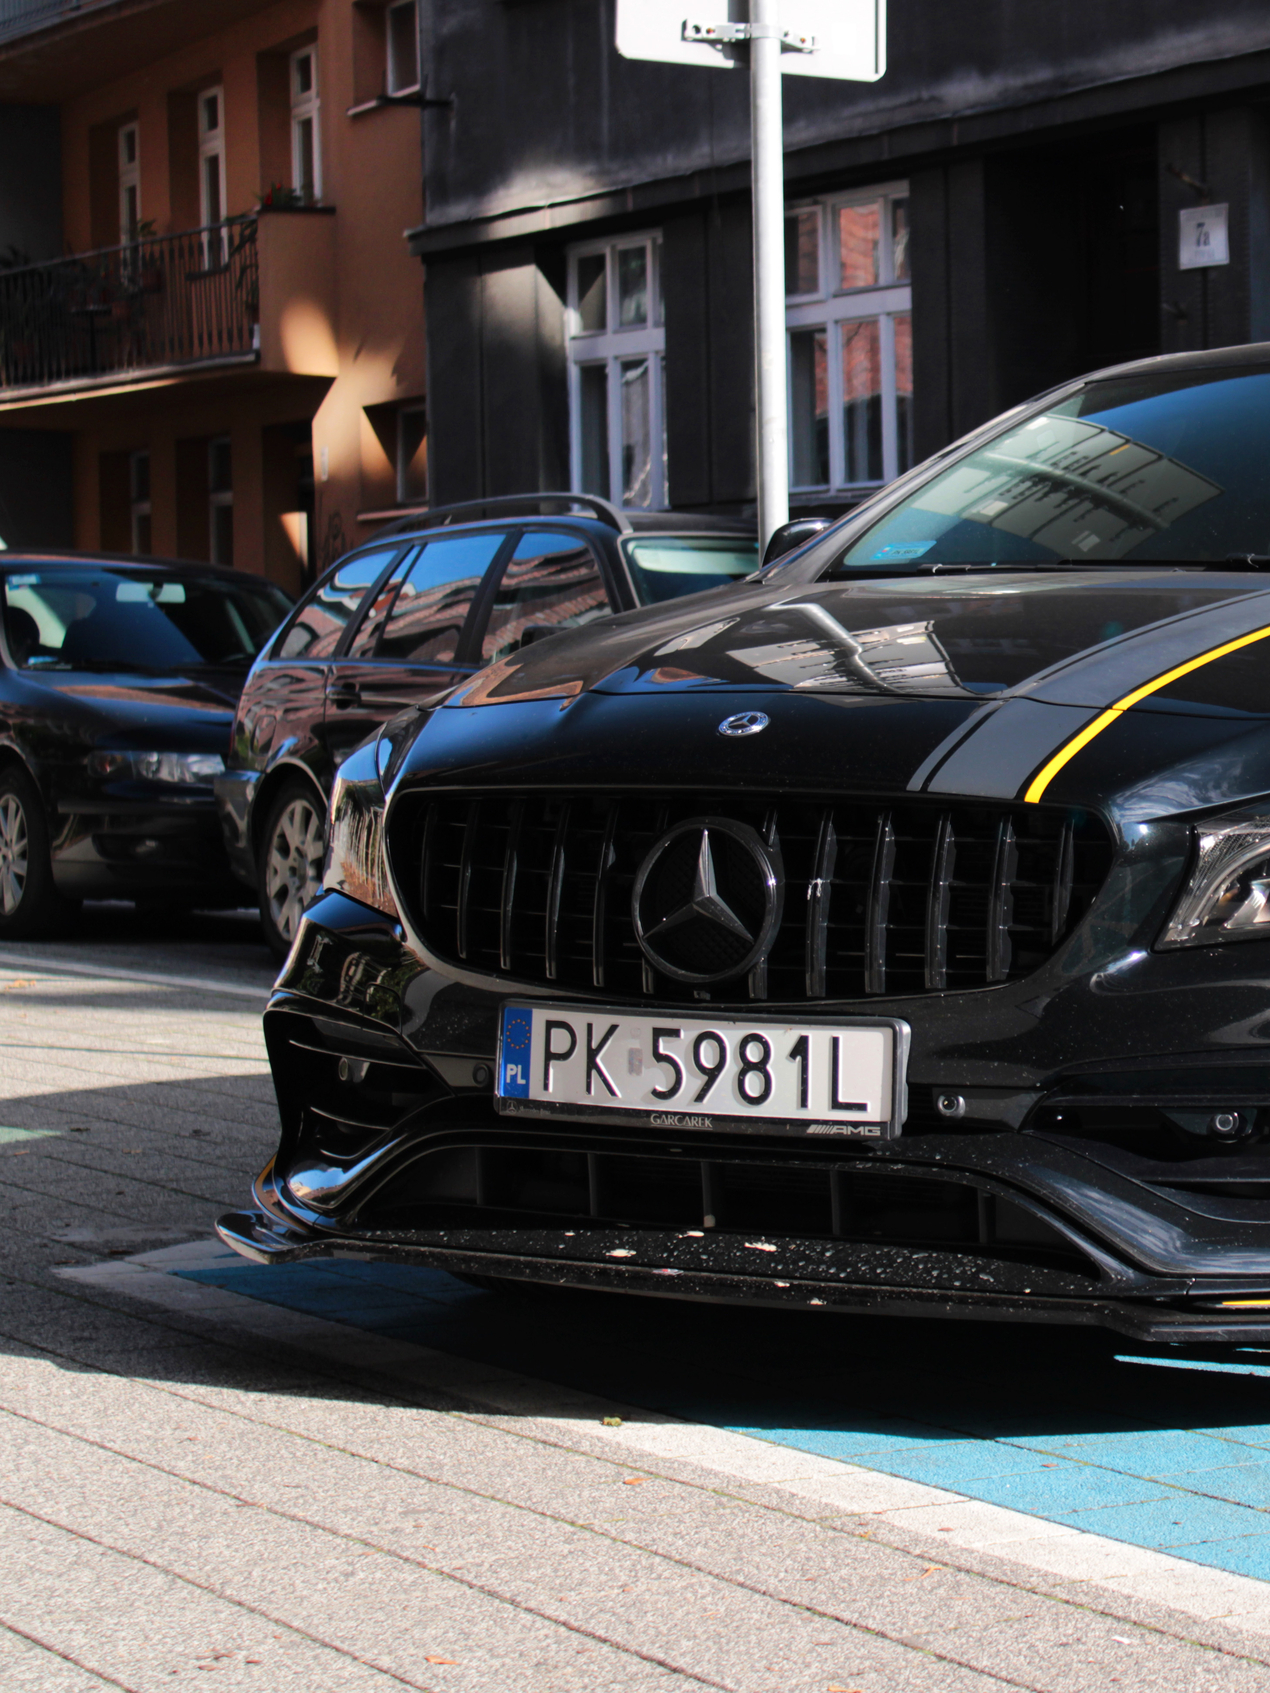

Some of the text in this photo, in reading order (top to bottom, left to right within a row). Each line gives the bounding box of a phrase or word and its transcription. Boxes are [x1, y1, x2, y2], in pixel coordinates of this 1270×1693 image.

[506, 1063, 527, 1086] PL
[542, 1019, 870, 1114] PK 5981L
[649, 1113, 714, 1129] GARCAREK
[829, 1125, 882, 1137] AMG
